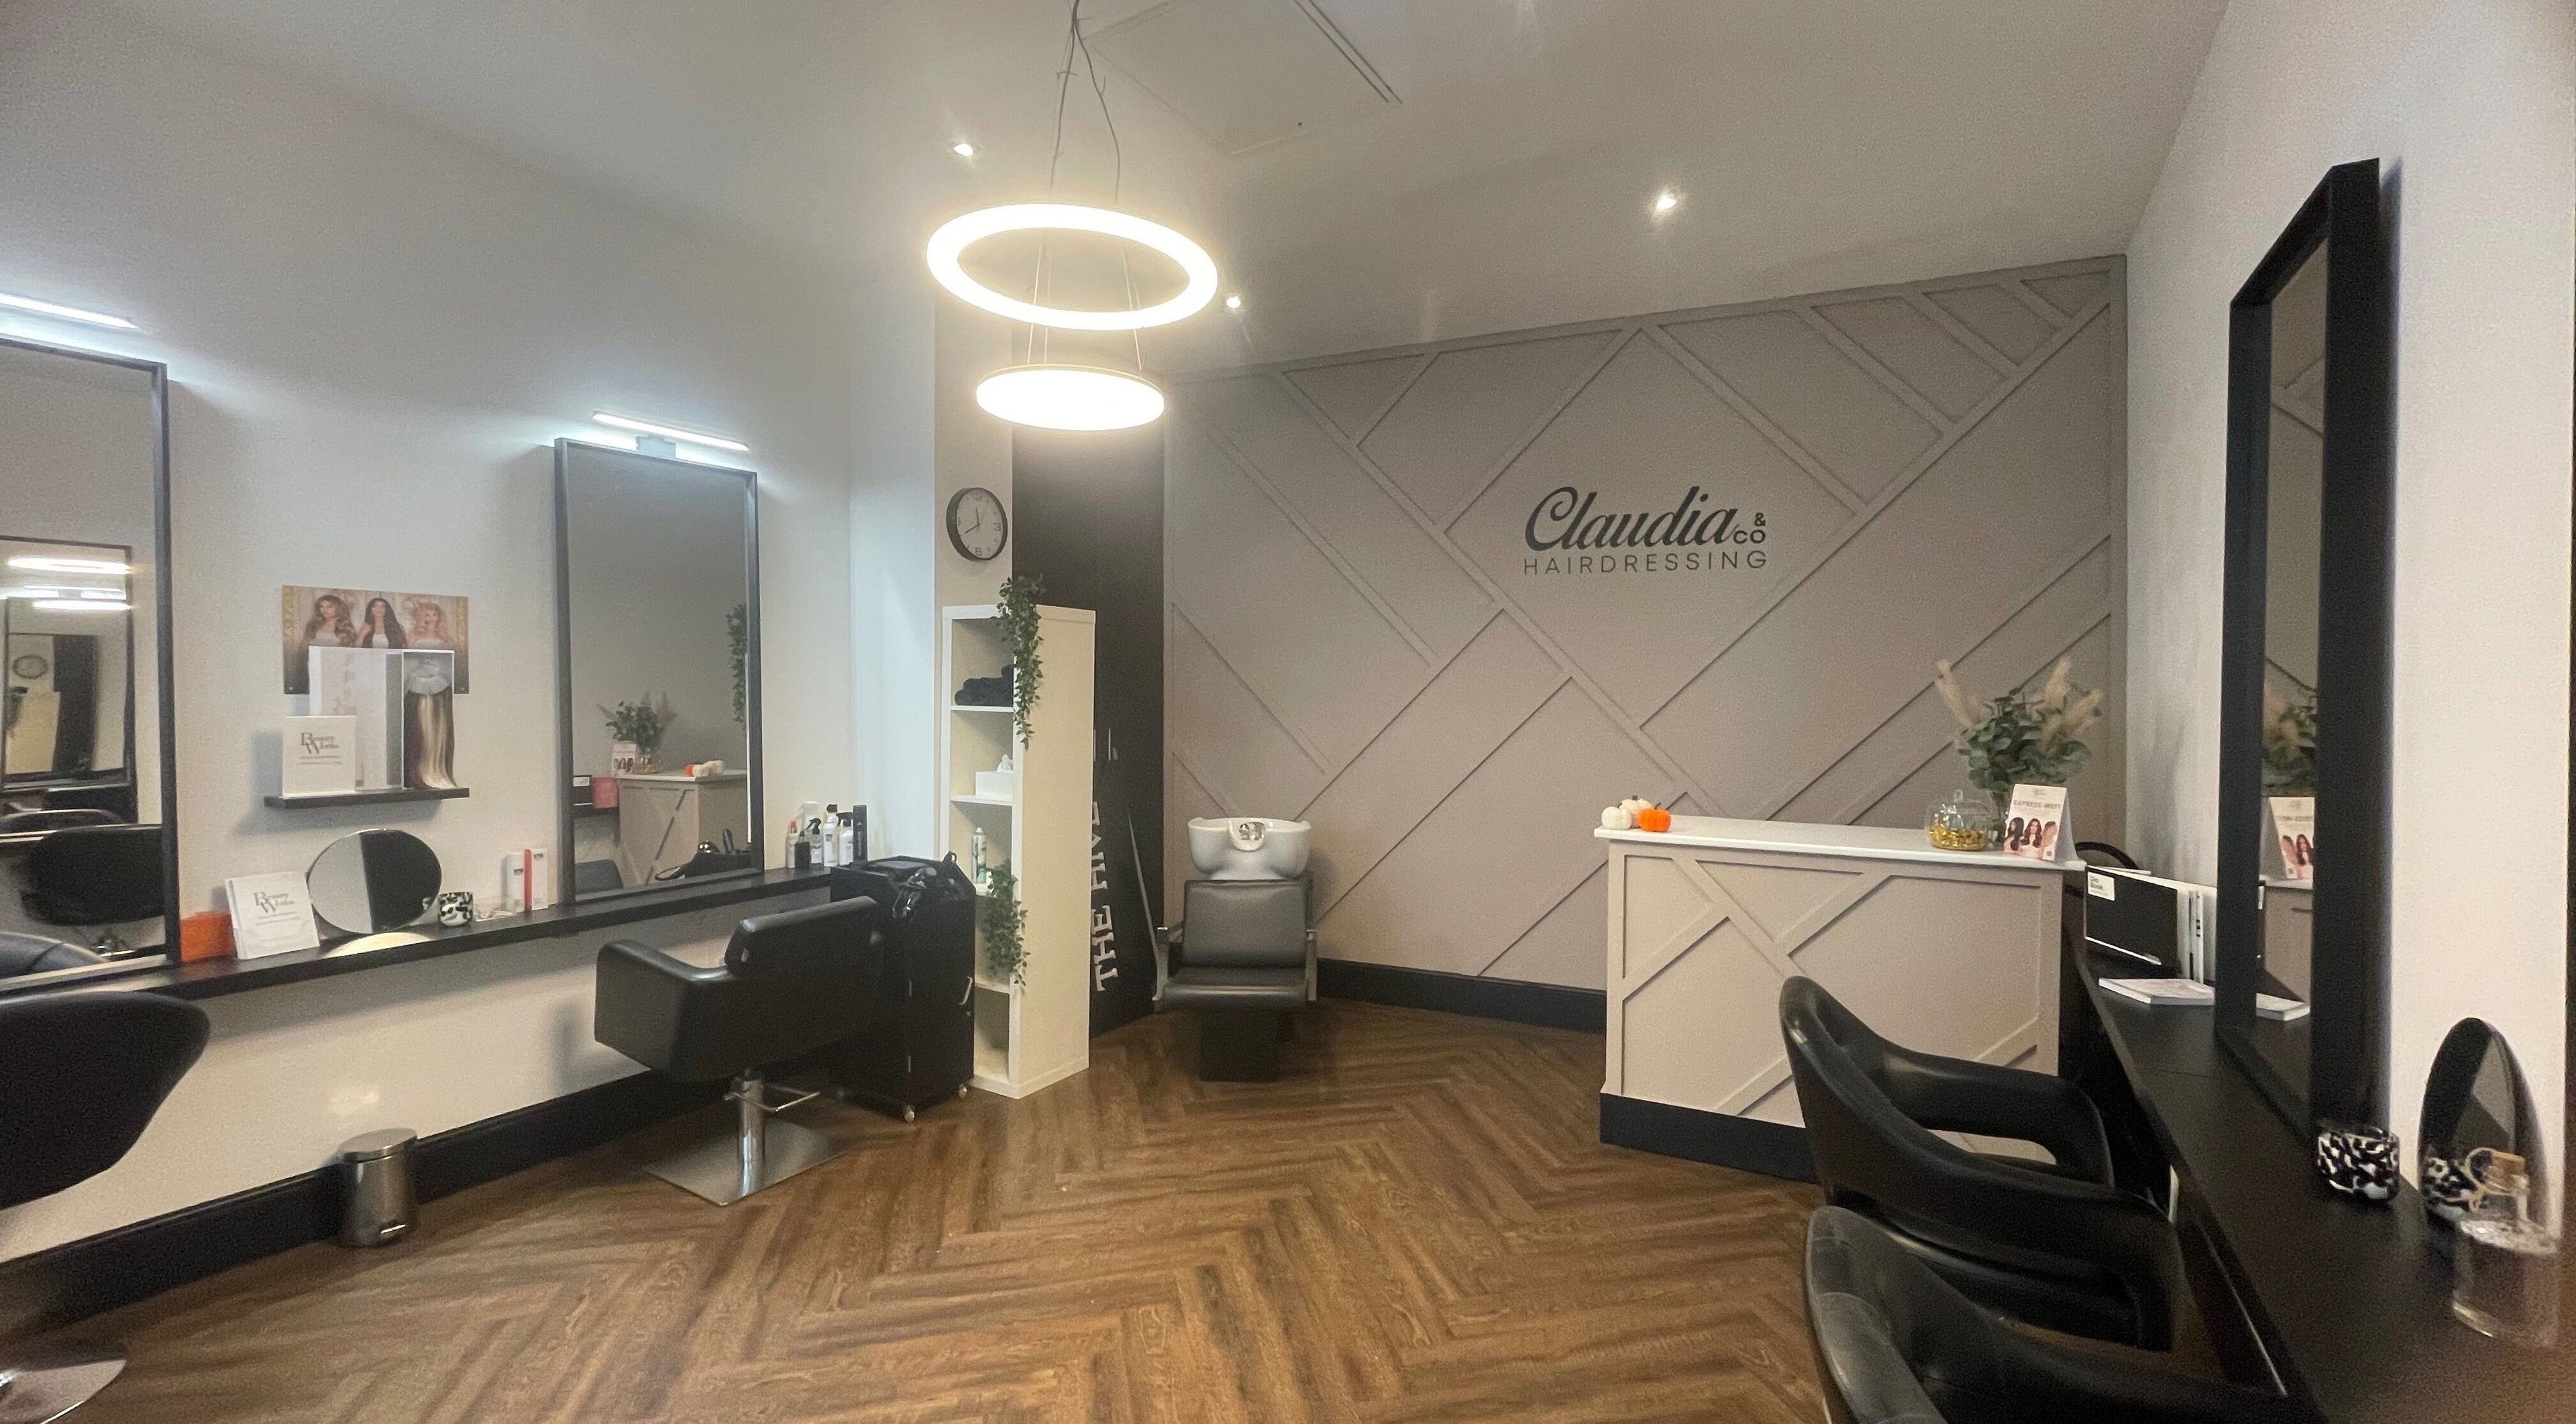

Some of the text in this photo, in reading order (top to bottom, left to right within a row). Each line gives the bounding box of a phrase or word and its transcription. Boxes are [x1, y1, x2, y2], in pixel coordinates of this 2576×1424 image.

[1525, 486, 1740, 551] Claudia
[1754, 512, 1766, 527] &
[1524, 550, 1766, 576] HAIRDRESSING
[1091, 905, 1118, 991] THE
